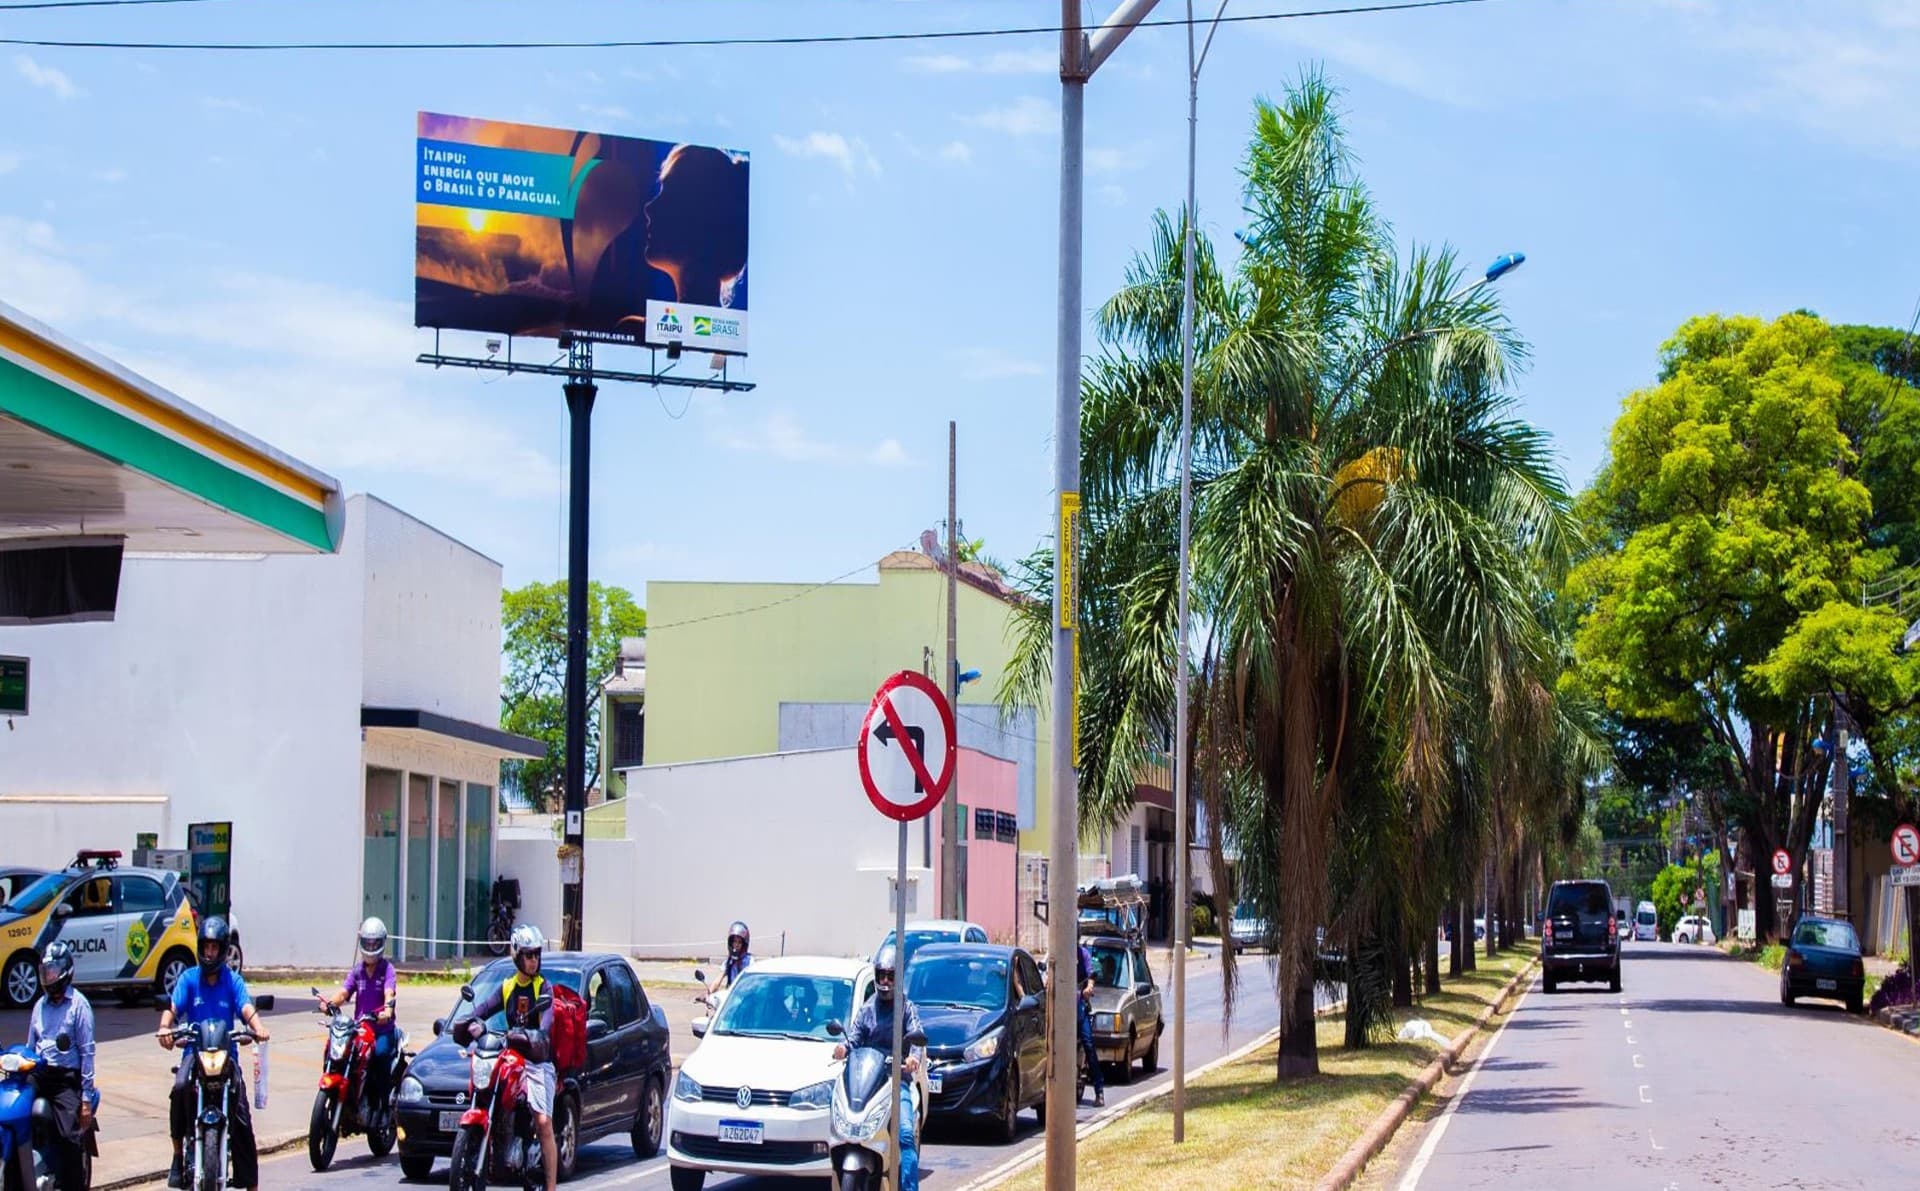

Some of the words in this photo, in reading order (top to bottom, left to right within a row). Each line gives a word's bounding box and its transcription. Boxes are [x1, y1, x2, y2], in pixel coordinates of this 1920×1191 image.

[424, 164, 473, 180] ENERGIA
[476, 170, 499, 185] QUE
[502, 174, 535, 187] MOVE
[656, 322, 683, 334] ITAIPU
[711, 325, 740, 337] BRASIL
